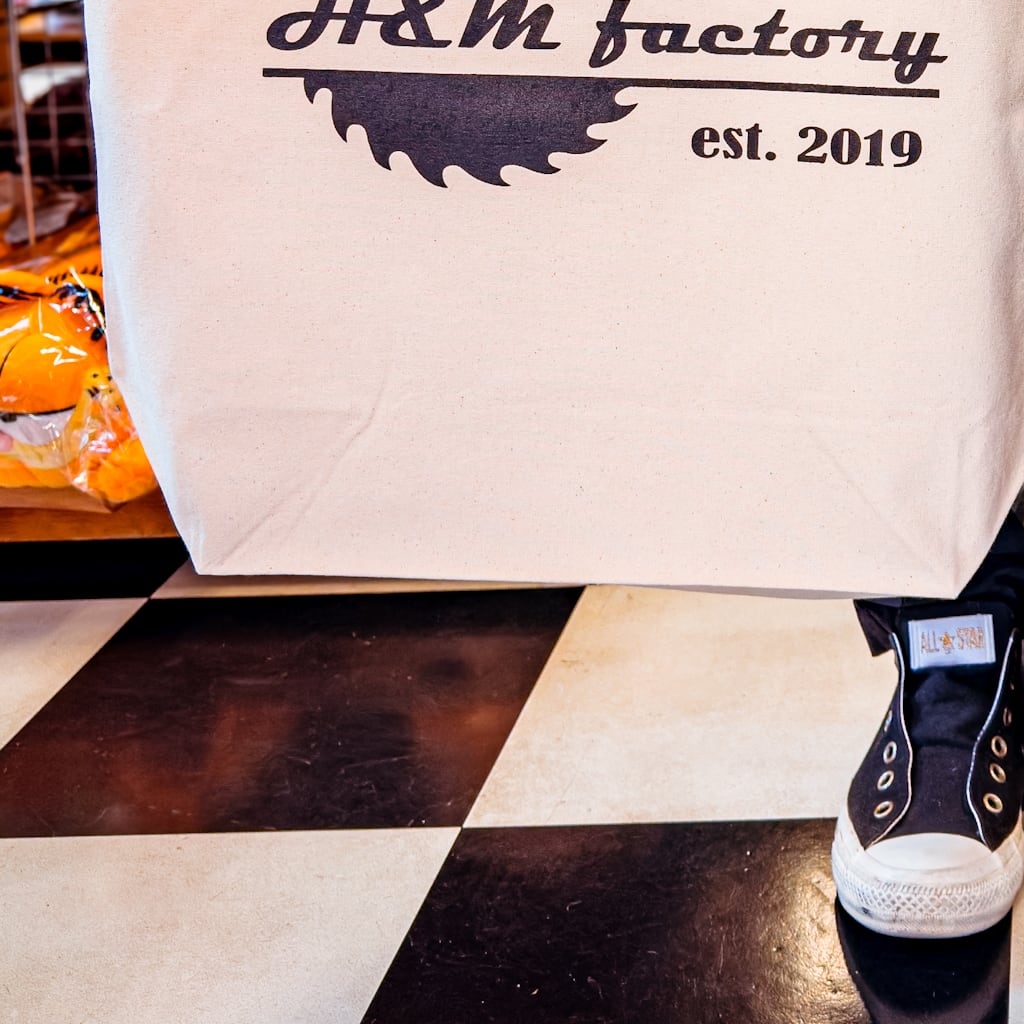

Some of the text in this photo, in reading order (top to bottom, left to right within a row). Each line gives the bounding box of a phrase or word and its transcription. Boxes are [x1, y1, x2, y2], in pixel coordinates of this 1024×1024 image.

[589, 0, 948, 85] factory
[692, 124, 922, 168] est. 2019
